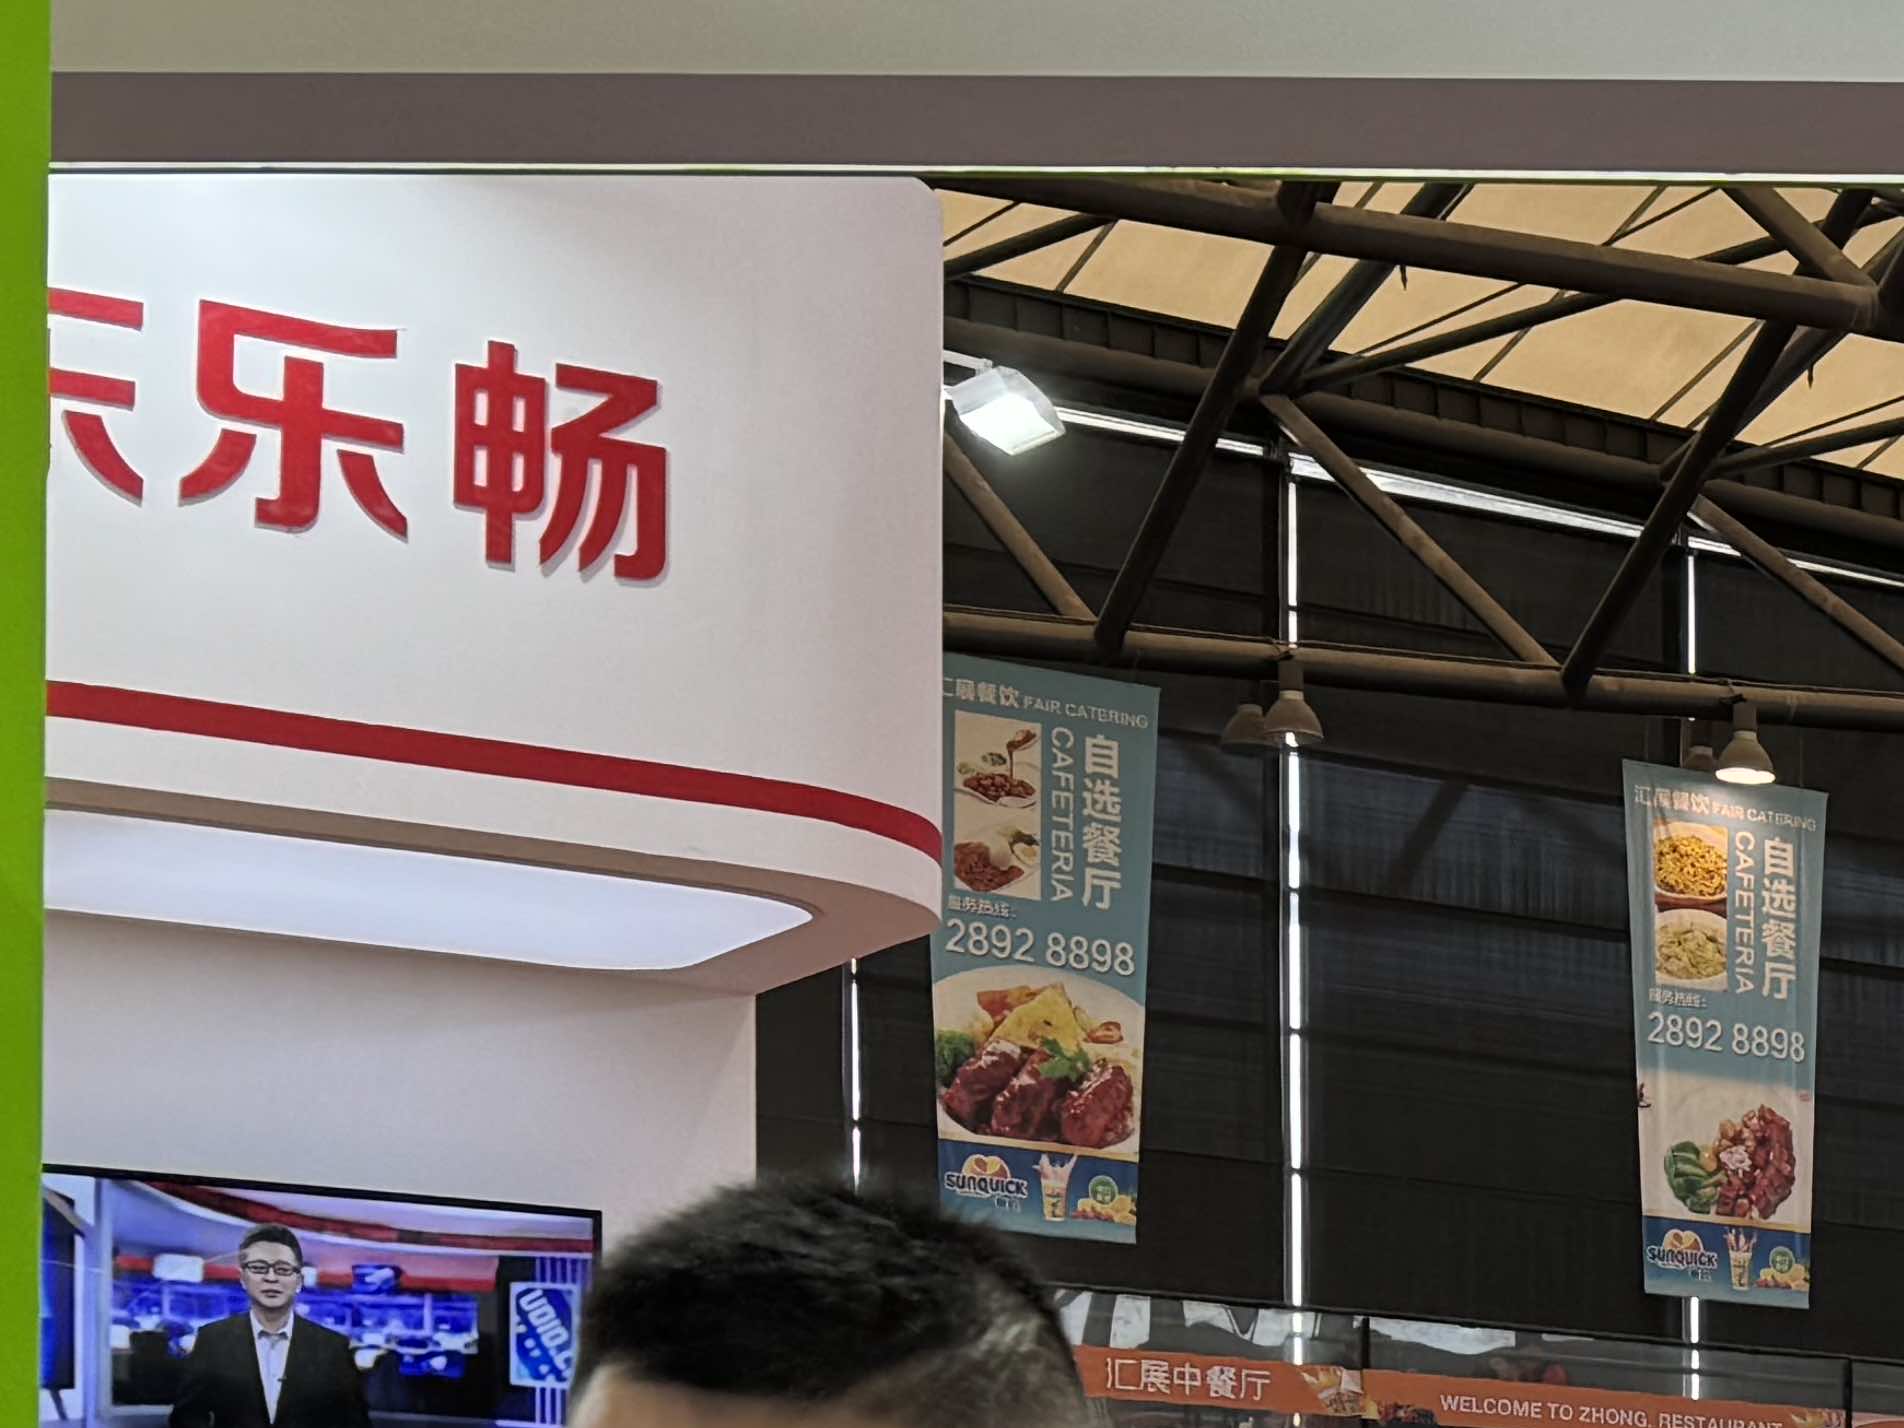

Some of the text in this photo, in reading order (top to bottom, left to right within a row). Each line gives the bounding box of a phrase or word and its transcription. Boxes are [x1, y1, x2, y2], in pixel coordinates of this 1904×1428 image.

[1023, 694, 1149, 730] FAIR CATERING
[1051, 725, 1075, 902] CAFETERIA
[1082, 733, 1122, 911] 自选餐厅
[1713, 801, 1817, 833] FAIR CATERING
[1733, 830, 1756, 994] CAFETERIA
[1762, 836, 1797, 1001] 自选餐厅
[945, 917, 1136, 977] 2892 8898
[1647, 1011, 1806, 1063] 2892 8898
[1106, 1357, 1271, 1402] 汇展中餐厅
[1439, 1393, 1543, 1420] WELCOME
[1546, 1402, 1574, 1422] TO
